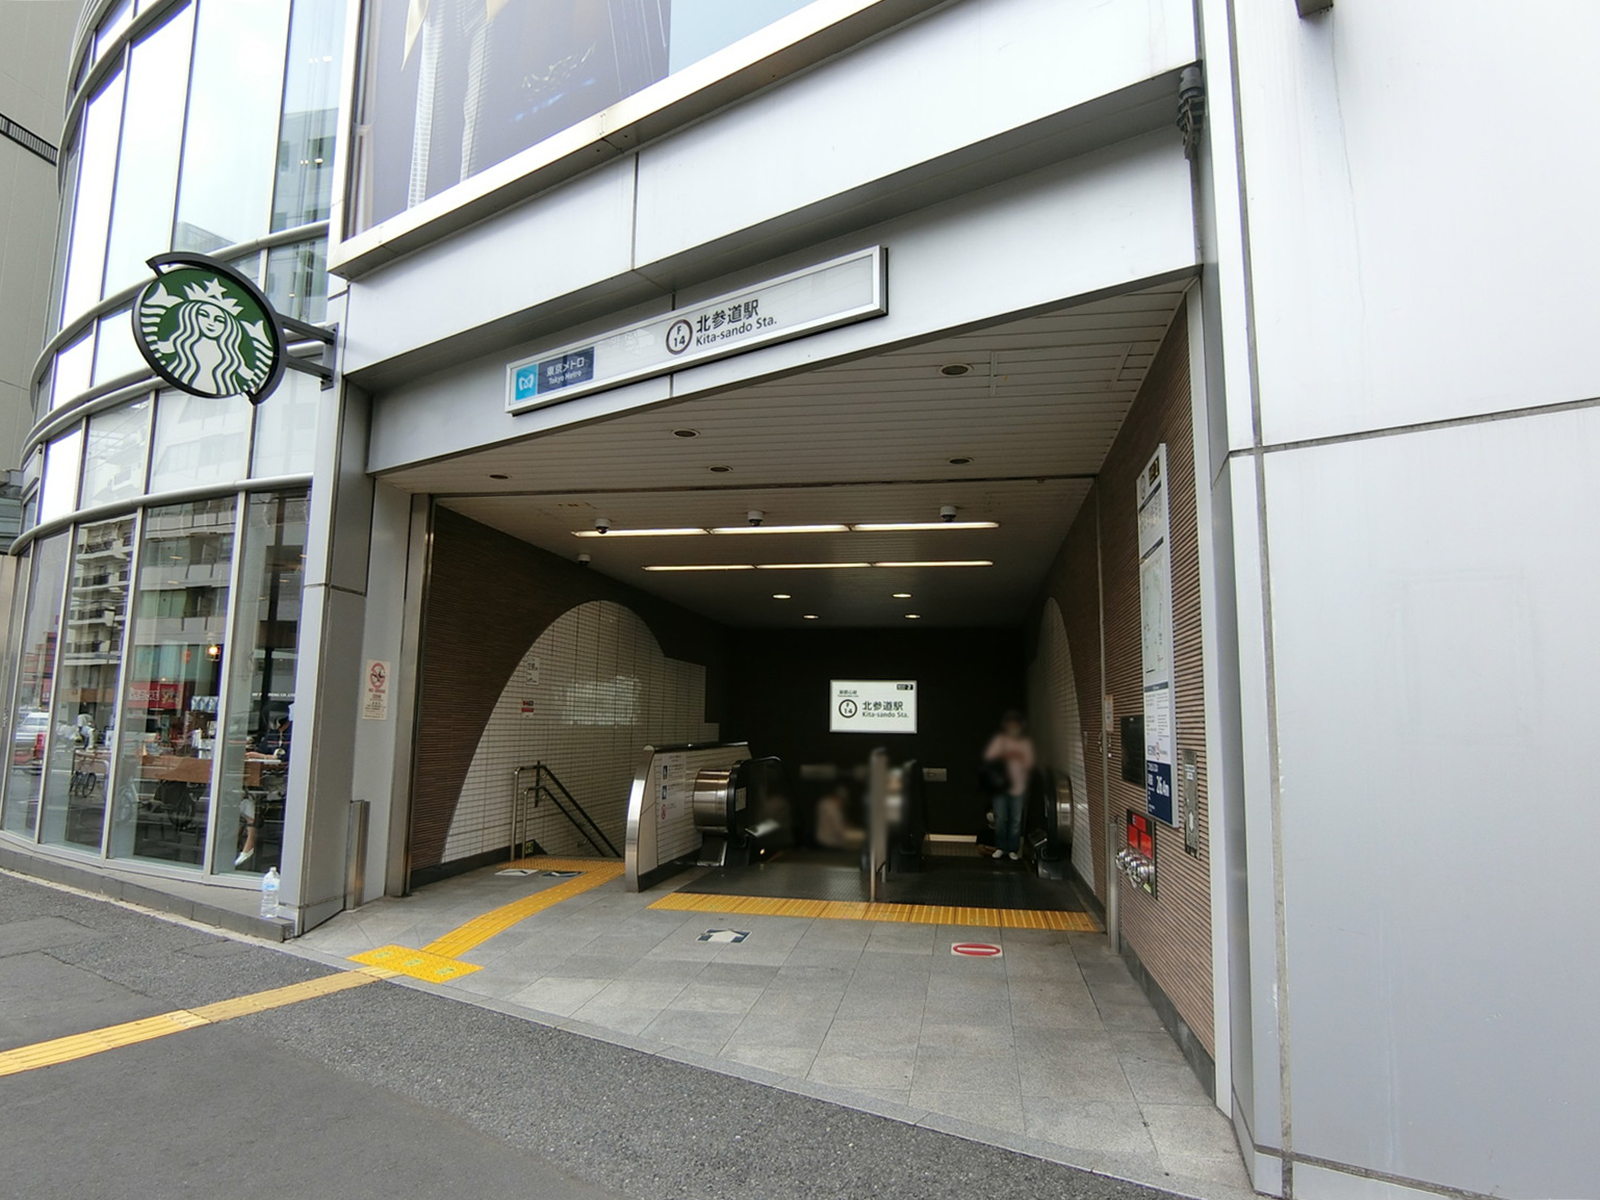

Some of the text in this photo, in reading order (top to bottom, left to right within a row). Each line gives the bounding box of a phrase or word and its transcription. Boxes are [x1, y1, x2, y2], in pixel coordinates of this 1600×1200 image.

[696, 299, 759, 334] 北参道駅
[676, 325, 682, 335] F
[696, 317, 777, 347] Kita-sando Sta.
[673, 335, 686, 347] 14
[546, 357, 585, 377] 東京メトロ
[548, 370, 583, 385] Tokyo Metro
[862, 701, 904, 711] 北参道駅
